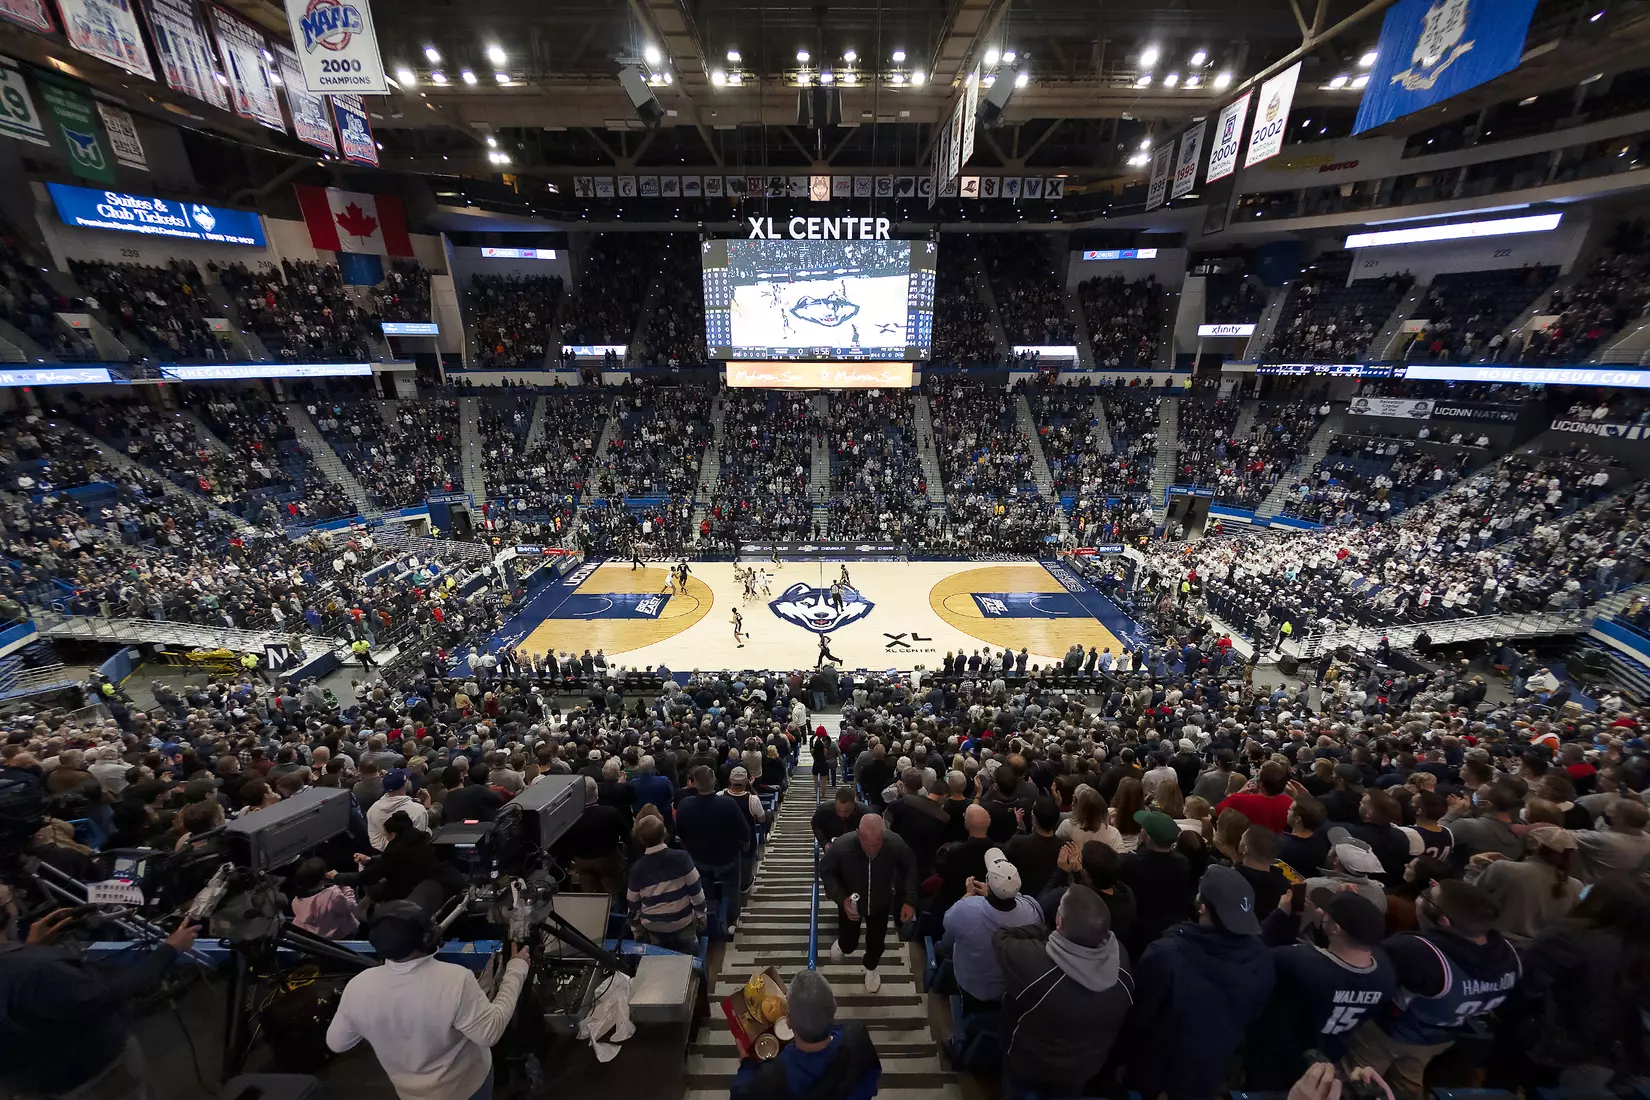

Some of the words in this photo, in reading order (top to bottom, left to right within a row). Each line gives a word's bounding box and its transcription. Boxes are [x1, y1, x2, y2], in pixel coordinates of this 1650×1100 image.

[300, 6, 362, 50] MAAC
[321, 59, 361, 72] 2000
[319, 77, 370, 85] CHAMPIONS
[1252, 118, 1284, 145] 2002
[1211, 141, 1238, 165] 2000
[1176, 162, 1196, 181] 1999
[1151, 178, 1166, 194] 1995
[104, 191, 152, 210] Suites
[153, 198, 169, 213] &
[97, 204, 134, 221] Club
[134, 208, 186, 228] Tickets
[748, 217, 782, 240] XL
[789, 216, 891, 240] CENTER
[121, 248, 140, 258] 239
[1492, 248, 1513, 258] 222
[1364, 260, 1380, 268] 221
[1211, 325, 1242, 335] xfinity
[1477, 369, 1642, 384] MOHEGANSUN.COM
[1434, 407, 1473, 417] UCONN
[1472, 410, 1520, 421] NATION
[1550, 419, 1602, 435] UCONN
[562, 561, 602, 587] UCONN
[883, 632, 933, 648] XL
[266, 647, 290, 669] N
[1332, 990, 1382, 1005] WALKER
[1320, 1006, 1368, 1035] 15
